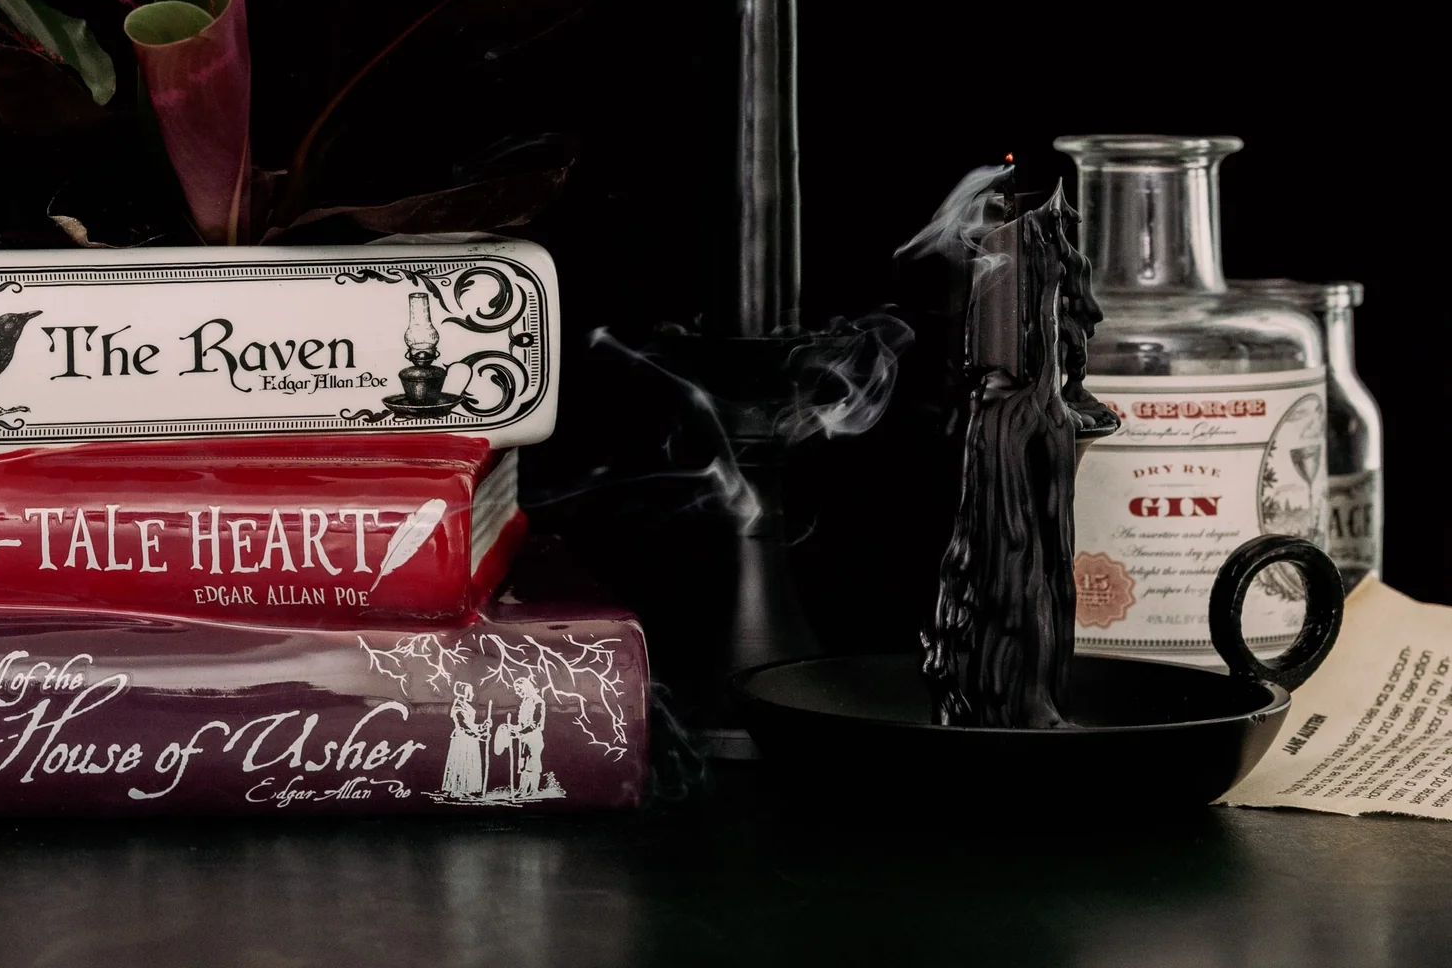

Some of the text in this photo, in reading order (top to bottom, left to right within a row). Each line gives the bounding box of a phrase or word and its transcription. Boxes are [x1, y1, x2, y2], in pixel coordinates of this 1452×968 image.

[41, 318, 356, 393] The Raven
[259, 372, 389, 395] Edgar Allan Poe
[1132, 399, 1266, 419] GEORGE
[1132, 464, 1221, 479] DRY RYE
[1128, 496, 1222, 518] GIN
[188, 504, 390, 578] HEART
[193, 585, 370, 608] EDGAR ALLAN POE
[44, 654, 93, 691] the
[128, 720, 228, 800] of
[223, 701, 426, 773] Usher
[1282, 736, 1308, 756] JANE
[1297, 713, 1328, 740] AUSTEN
[245, 775, 316, 808] Edgar
[313, 776, 372, 802] Allan
